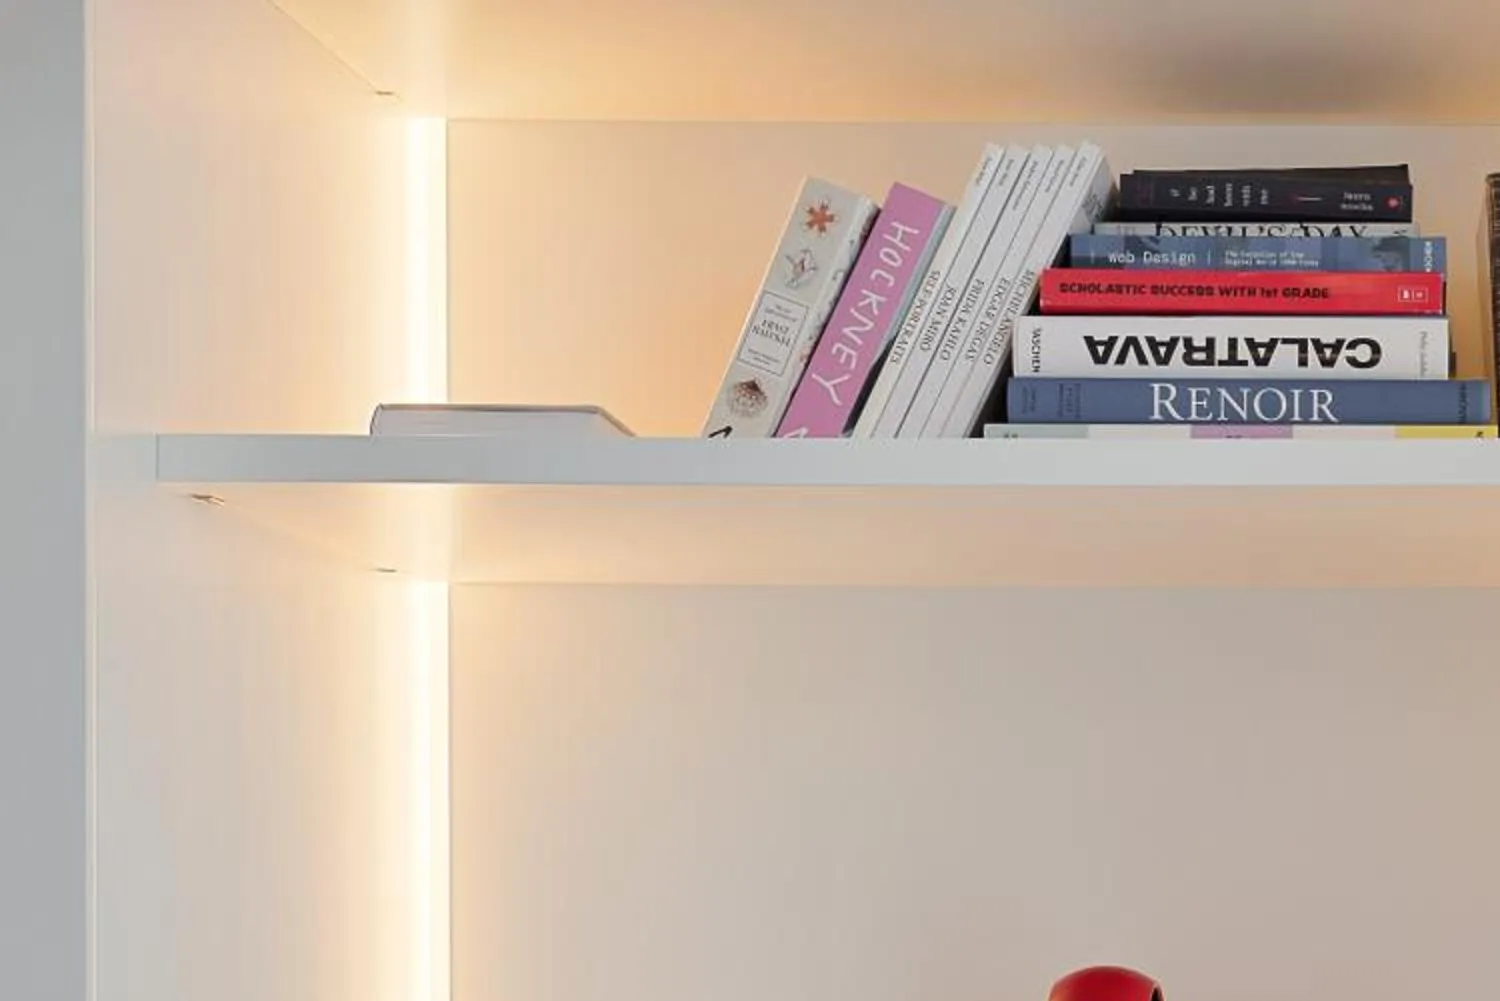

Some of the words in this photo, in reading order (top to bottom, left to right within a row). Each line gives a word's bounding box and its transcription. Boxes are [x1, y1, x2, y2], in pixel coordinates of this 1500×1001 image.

[1143, 250, 1197, 267] Design
[1059, 281, 1147, 296] SCHOLASTIC
[1150, 283, 1215, 297] SUCCESS
[1217, 286, 1257, 298] WITH
[1282, 287, 1330, 299] GRADE
[811, 220, 920, 406] HOCKNEY
[1031, 328, 1043, 373] TASCHEN
[1083, 335, 1382, 369] CALATRAVA
[1149, 382, 1340, 422] RENOIR
